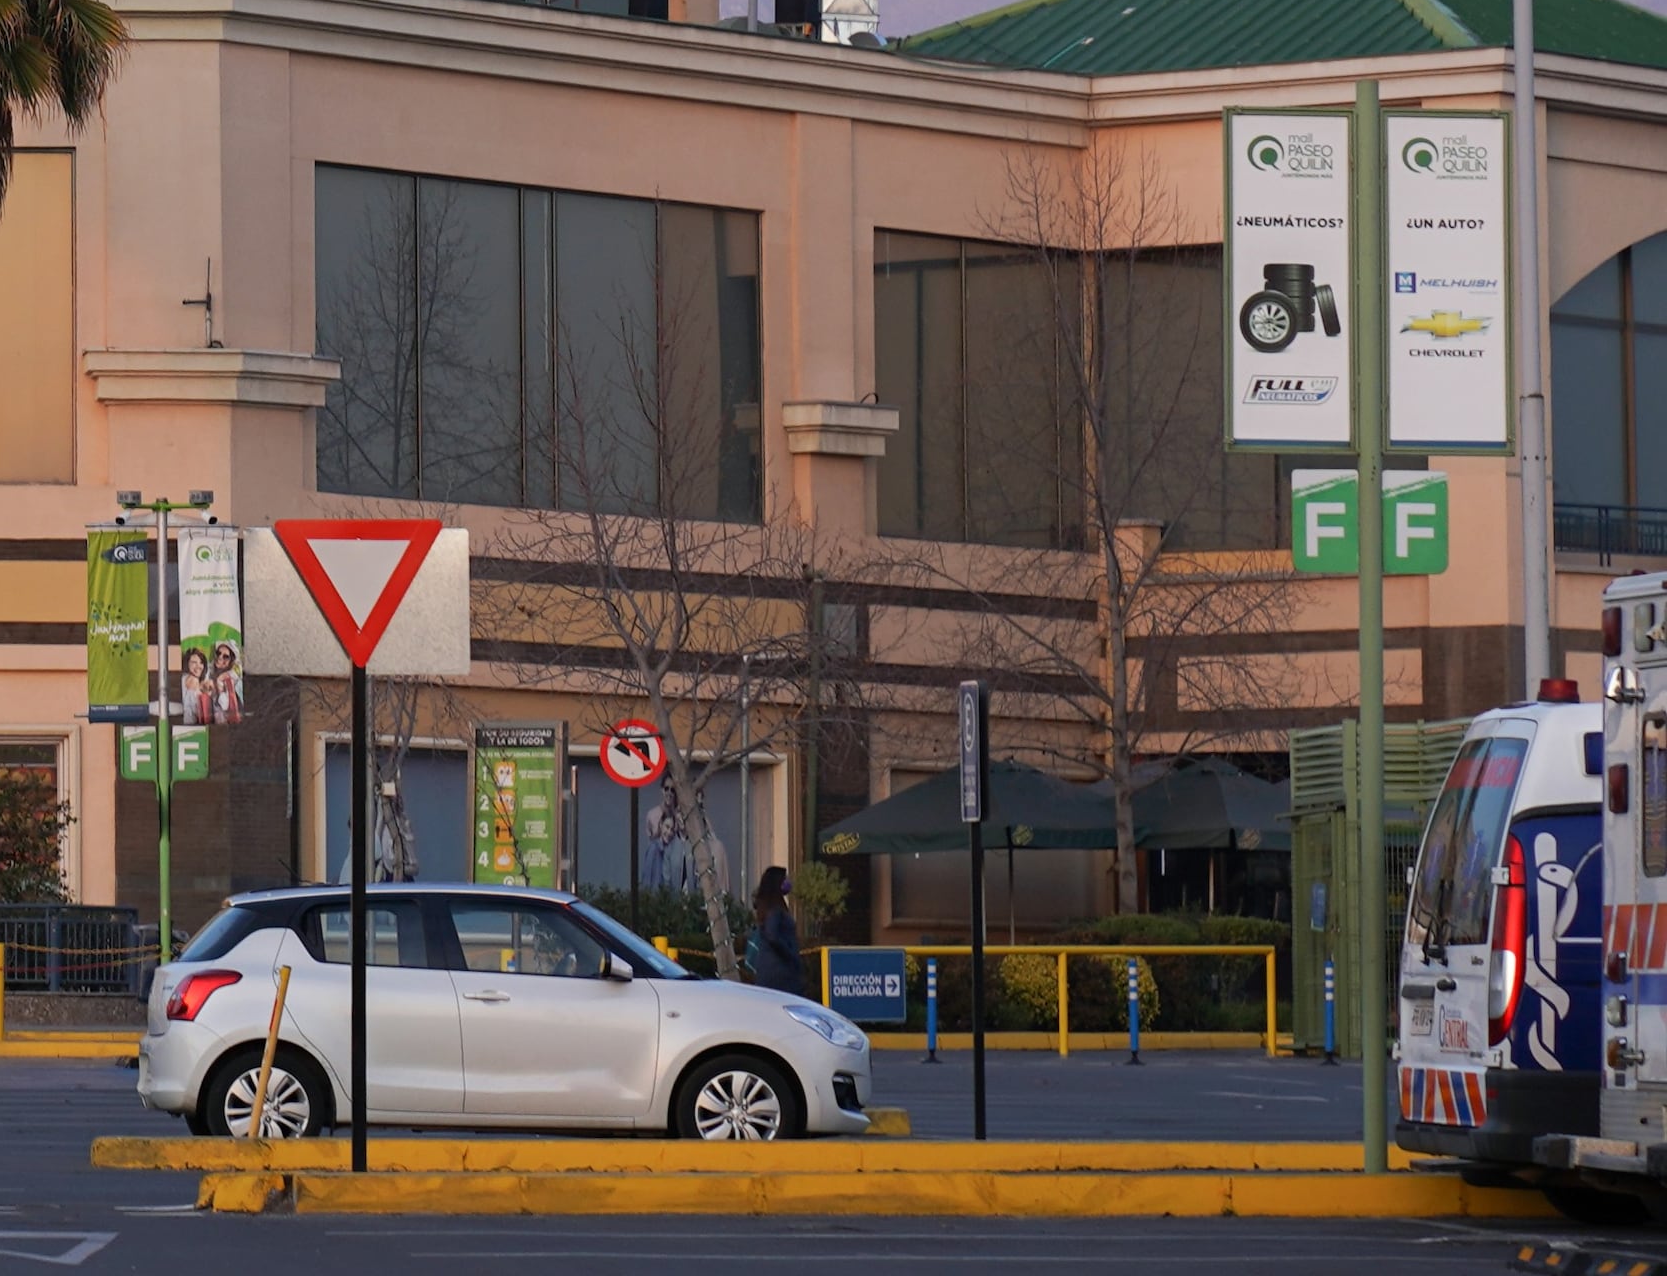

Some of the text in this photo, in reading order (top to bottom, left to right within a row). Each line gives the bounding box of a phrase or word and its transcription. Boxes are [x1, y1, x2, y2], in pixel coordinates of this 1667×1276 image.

[1288, 133, 1312, 143] mall
[1442, 135, 1467, 145] mall
[1288, 144, 1333, 157] PASEO
[1442, 146, 1487, 159] PASEO
[1236, 214, 1344, 228] ¿NEUMÁTICOS?
[1406, 218, 1484, 230] ¿UN AUTO?
[1409, 349, 1485, 358] CHEVROLET
[1305, 502, 1346, 558] F
[1395, 502, 1436, 558] F
[130, 741, 152, 772] F
[178, 741, 199, 771] F
[480, 795, 490, 811] 2
[479, 821, 489, 838] 3
[478, 851, 489, 867] 4
[833, 973, 882, 985] DIRECCIÓN
[833, 985, 882, 997] OBLIGADA
